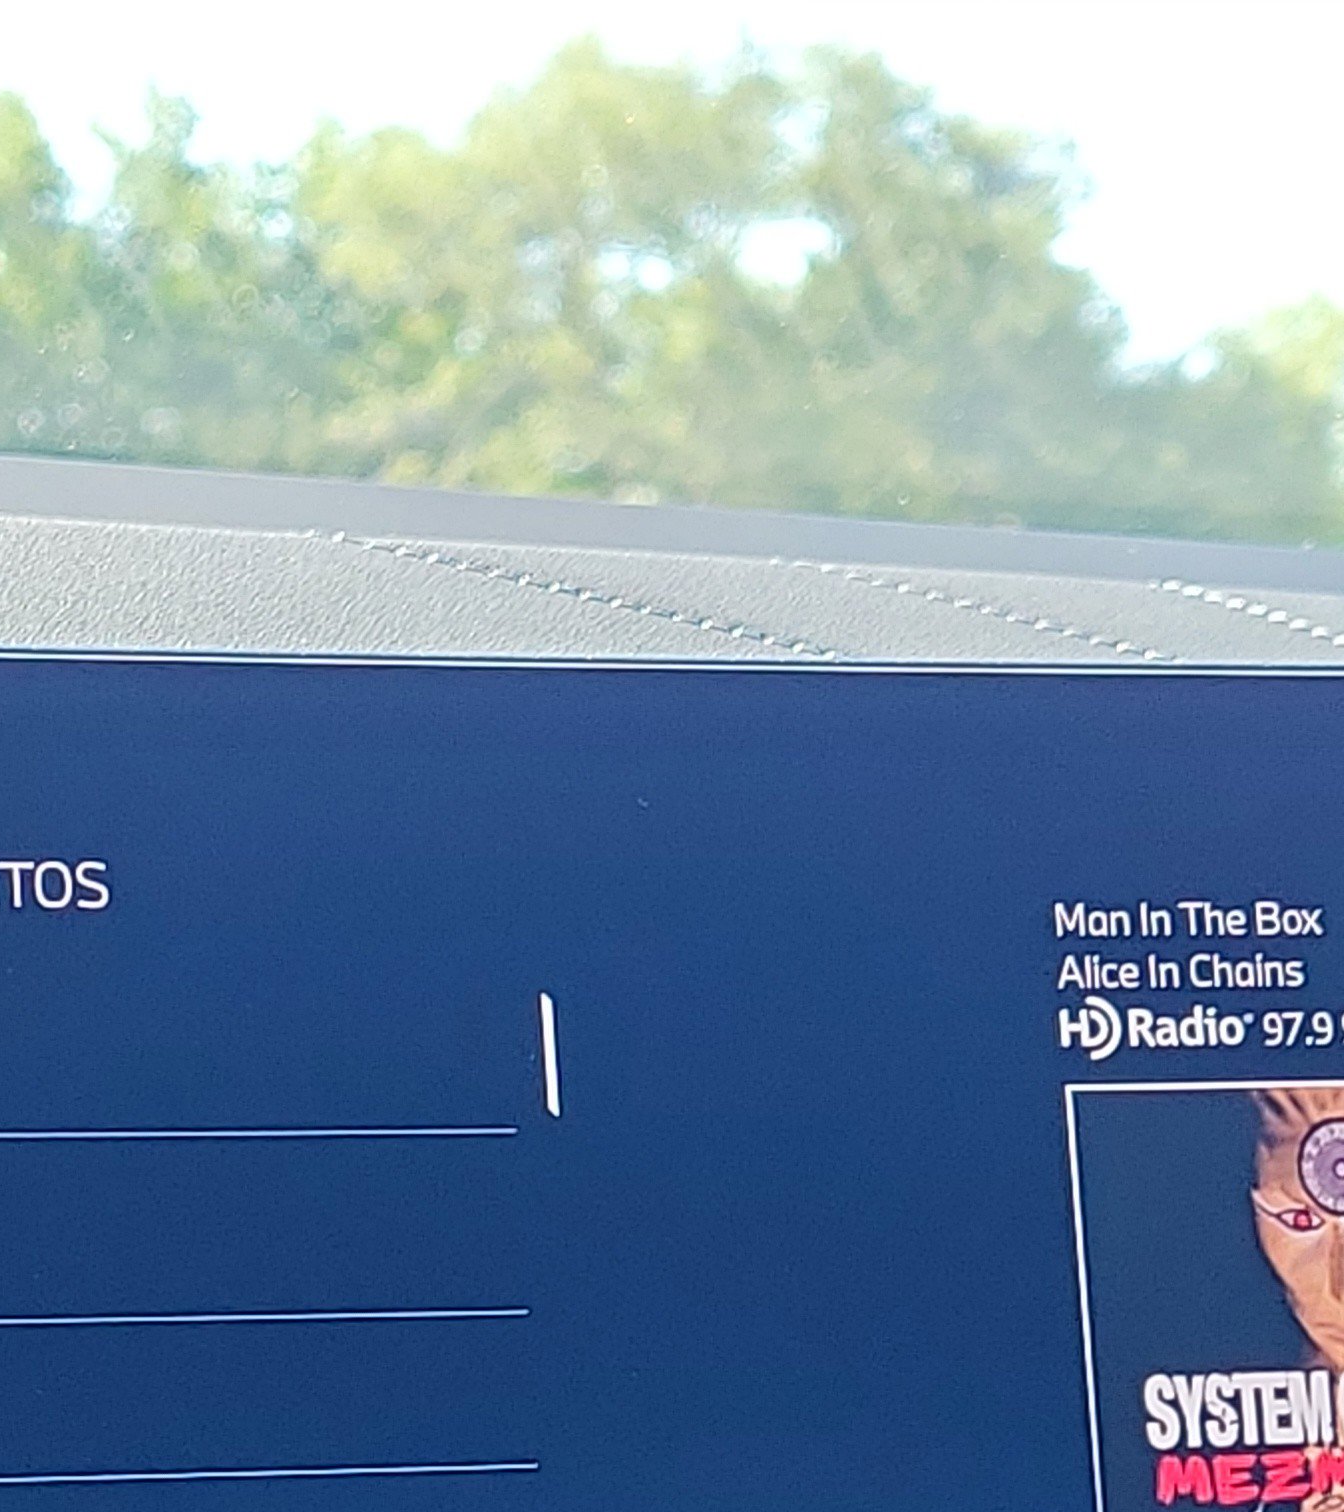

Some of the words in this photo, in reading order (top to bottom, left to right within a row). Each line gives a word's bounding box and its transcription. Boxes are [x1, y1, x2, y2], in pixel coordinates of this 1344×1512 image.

[1055, 902, 1131, 938] Man
[1140, 902, 1172, 937] In
[1177, 901, 1248, 936] The
[1255, 900, 1323, 936] Box
[1058, 955, 1140, 990] Alice
[1149, 954, 1180, 989] In
[1189, 953, 1305, 988] Chains
[1128, 1005, 1246, 1046] Radio
[1263, 1010, 1333, 1046] 97.9
[1144, 1370, 1334, 1449] SYSTEM
